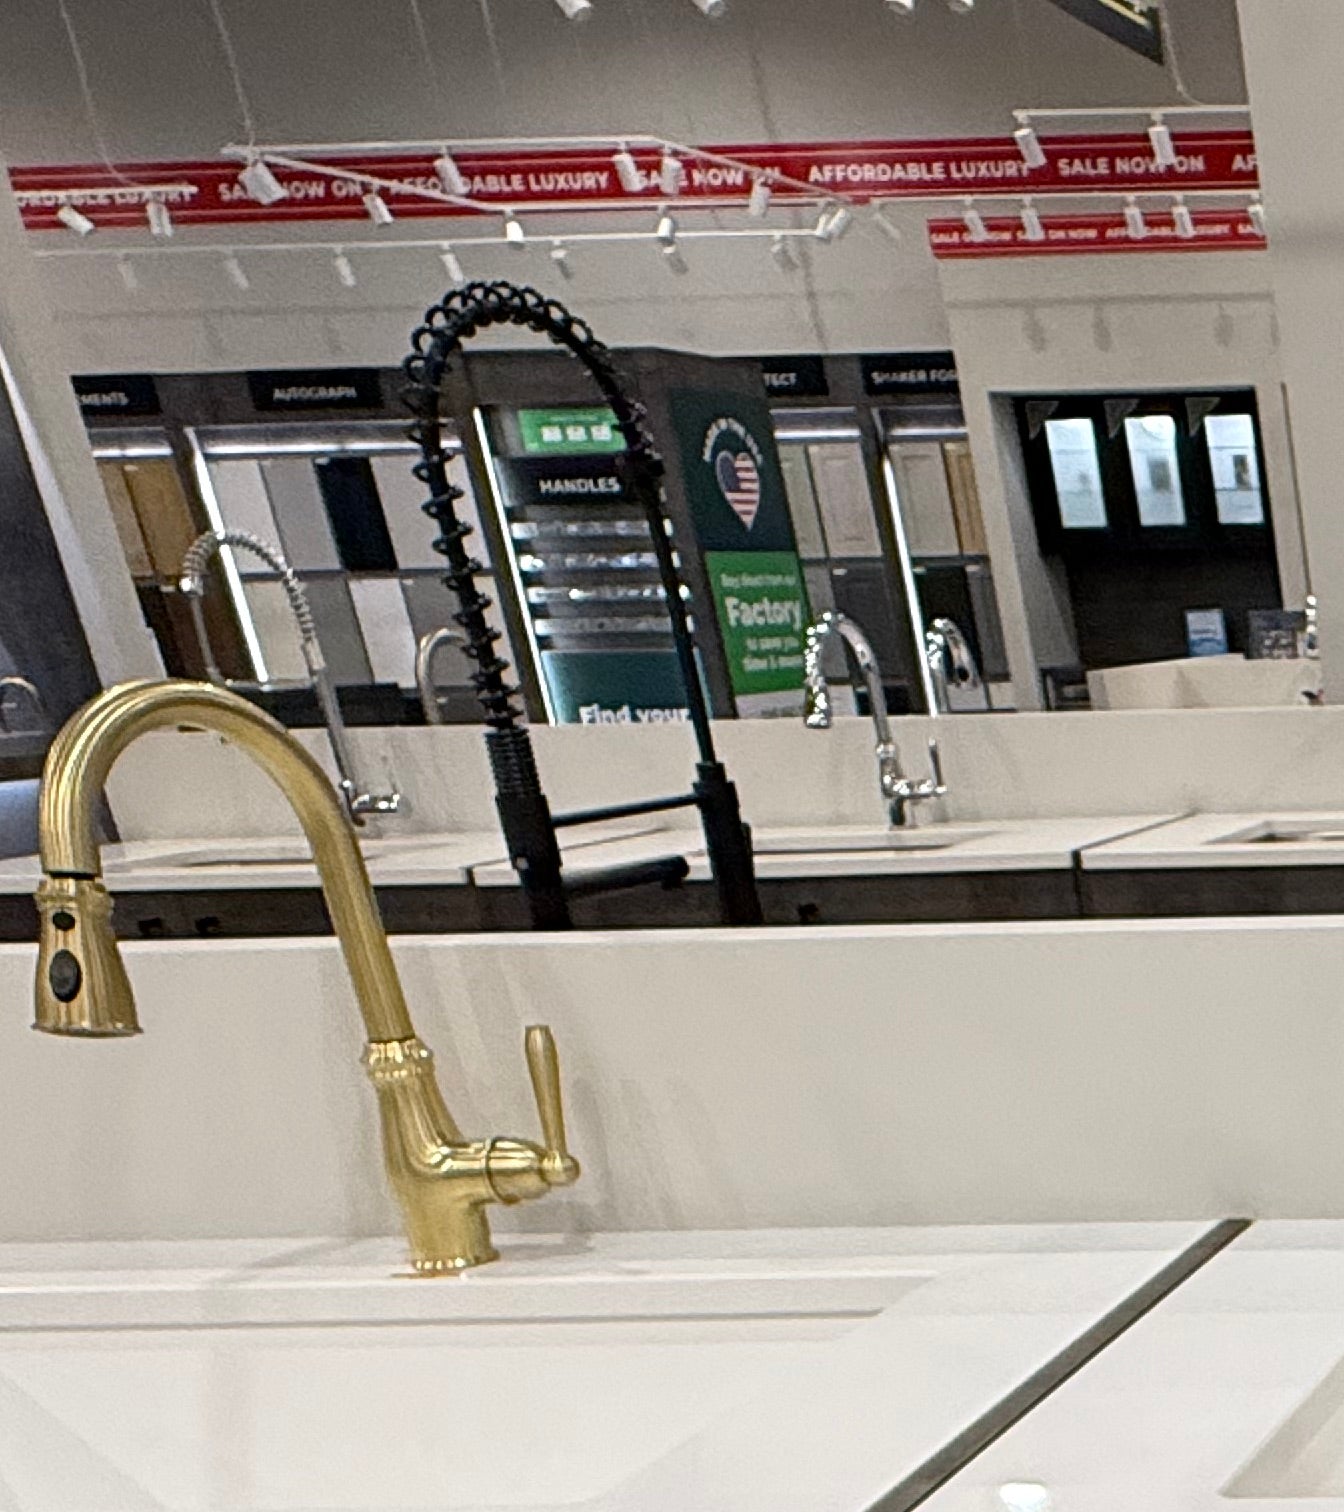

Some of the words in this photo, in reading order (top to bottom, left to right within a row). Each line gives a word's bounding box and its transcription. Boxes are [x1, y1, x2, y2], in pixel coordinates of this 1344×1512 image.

[528, 170, 609, 192] LUXURY
[809, 161, 946, 182] AFFORDABLE
[1057, 157, 1110, 176] SALE
[538, 475, 622, 495] HANDLES
[724, 596, 802, 631] Factory
